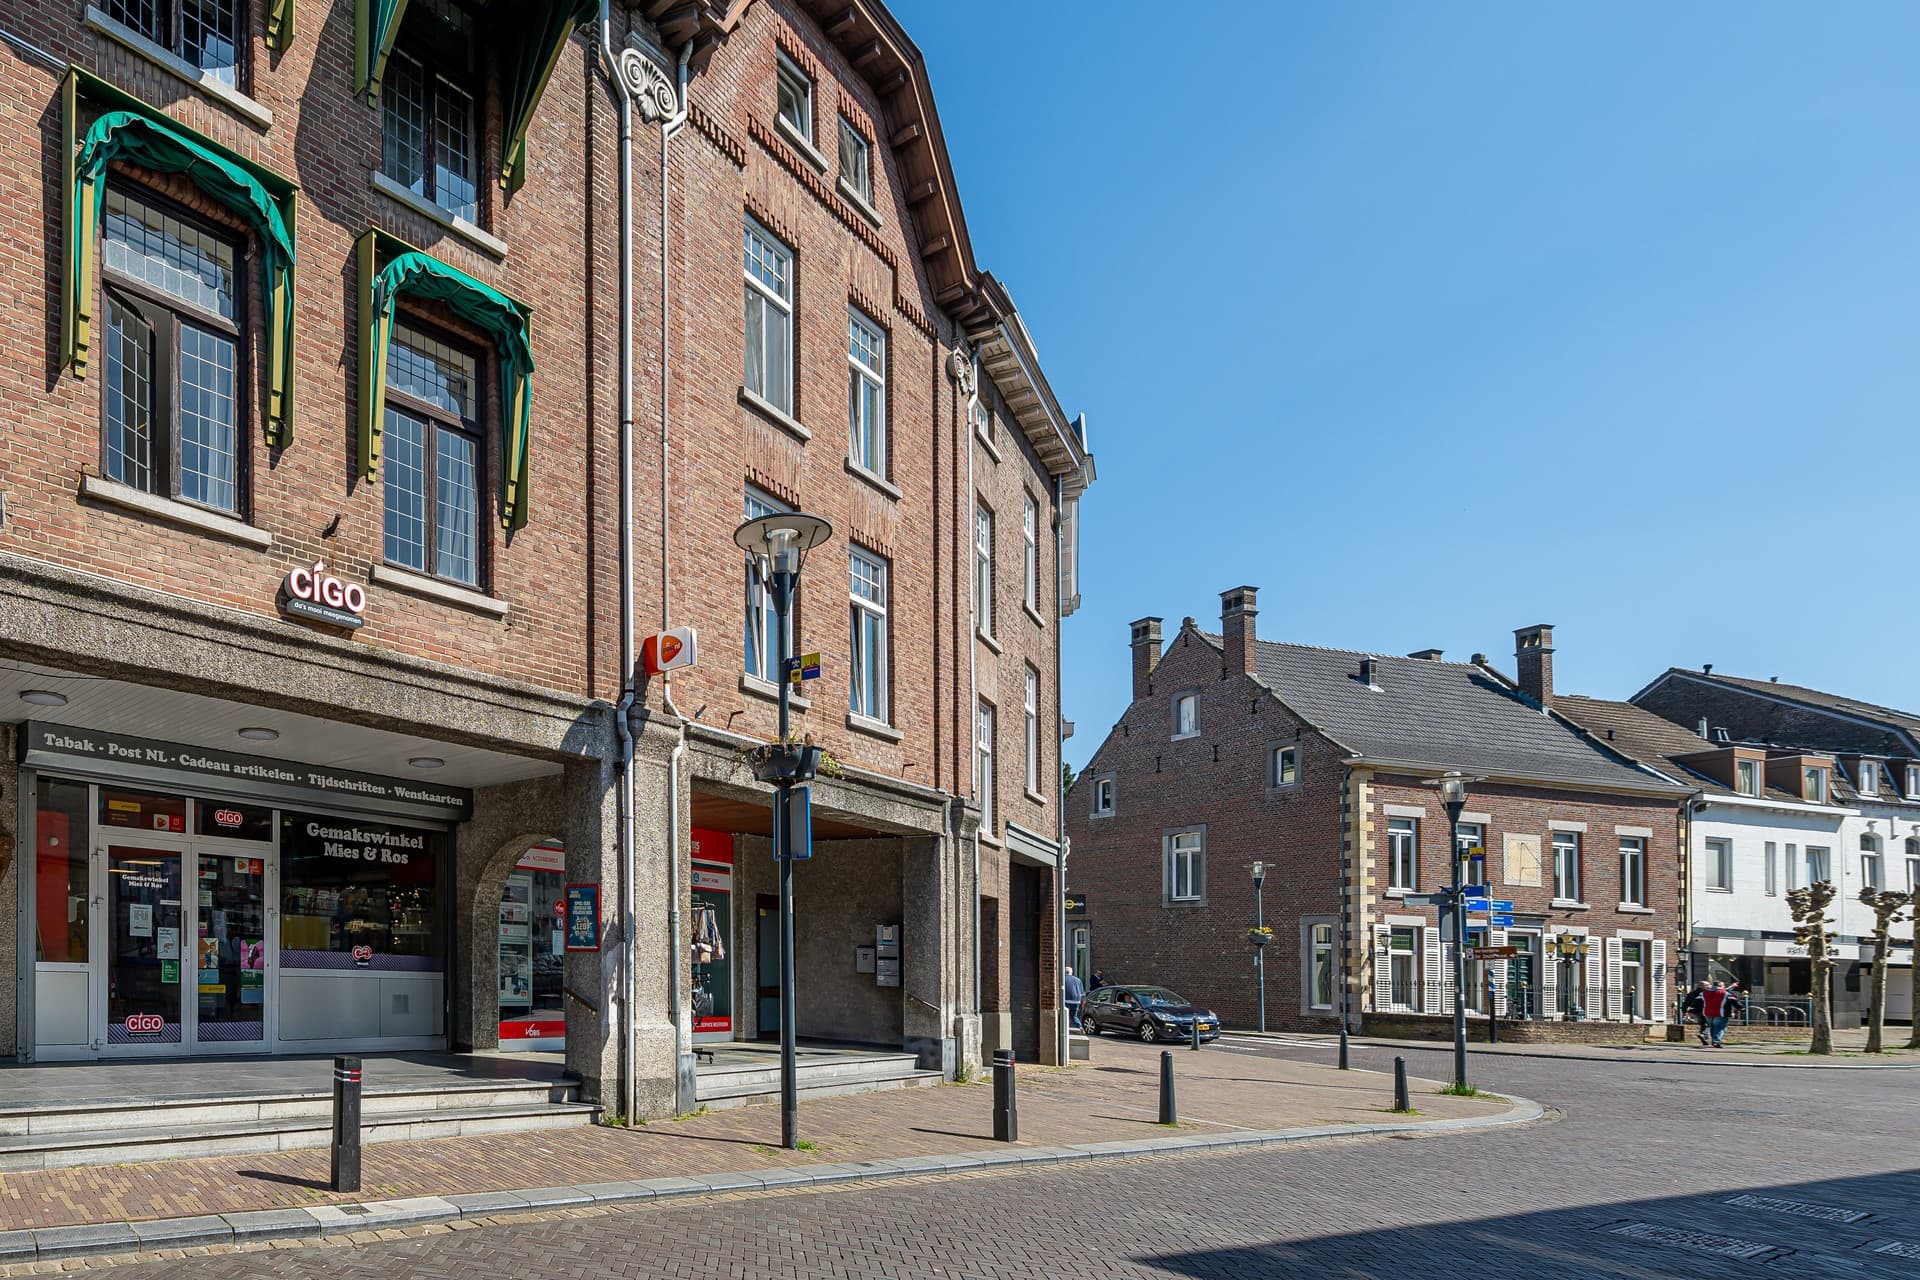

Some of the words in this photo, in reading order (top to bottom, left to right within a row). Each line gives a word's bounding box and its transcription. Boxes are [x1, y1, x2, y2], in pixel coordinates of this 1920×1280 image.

[44, 732, 95, 752] Tabak
[108, 742, 143, 759] Post
[146, 749, 168, 763] NL
[179, 754, 231, 772] Cadeau
[234, 764, 295, 782] artikelen
[308, 773, 386, 795] Tijdschriften
[394, 786, 463, 806] Wenskaarten
[306, 822, 424, 849] Gemakswinkel
[323, 841, 360, 860] Mies
[363, 846, 377, 861] &
[381, 848, 409, 864] Ros
